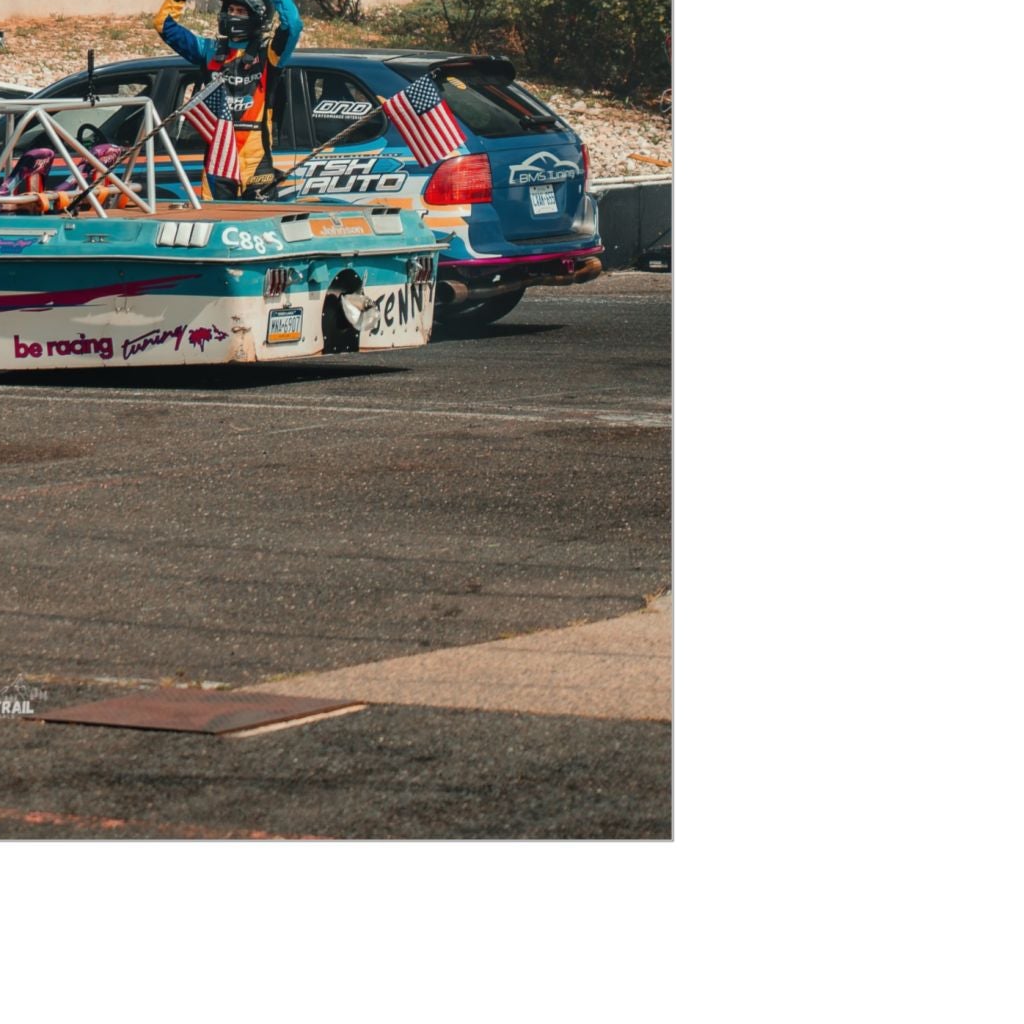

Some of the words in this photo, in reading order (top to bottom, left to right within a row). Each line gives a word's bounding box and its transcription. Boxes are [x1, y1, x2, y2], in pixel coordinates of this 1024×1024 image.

[303, 158, 377, 176] TSH
[301, 174, 406, 195] AUTO
[14, 335, 43, 358] be
[47, 333, 114, 360] racing
